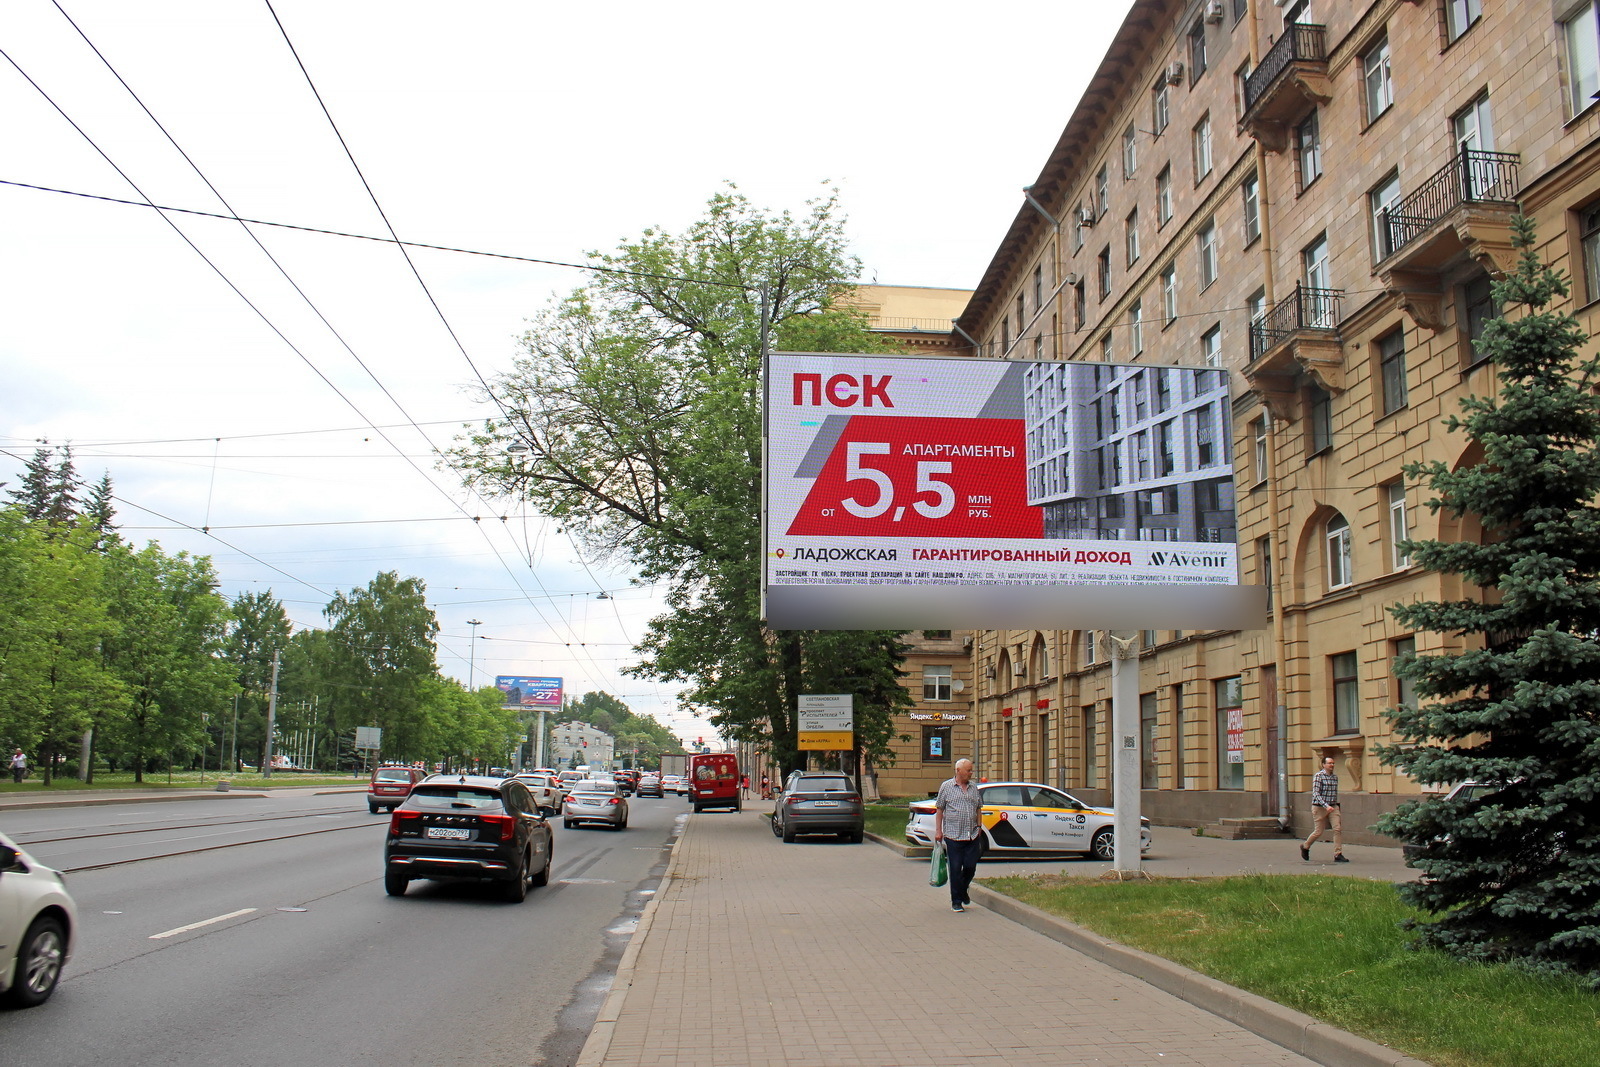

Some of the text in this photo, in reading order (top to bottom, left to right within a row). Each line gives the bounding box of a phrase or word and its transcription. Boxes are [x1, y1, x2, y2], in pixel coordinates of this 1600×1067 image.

[793, 373, 894, 408] ПСК
[903, 443, 1015, 458] АПАРТАМЕНТЫ
[821, 441, 956, 522] ОТ 5,5
[968, 495, 992, 504] МЛН
[968, 509, 992, 518] РУБ.
[793, 548, 897, 562] ЛАДОЖСКАЯ
[912, 547, 1132, 565] ГАРАНТИРОВАННЫЙ ДОХОД
[1169, 553, 1228, 567] Avenir
[910, 712, 966, 721] Яндекс Маркет
[423, 815, 477, 823] HAVAL
